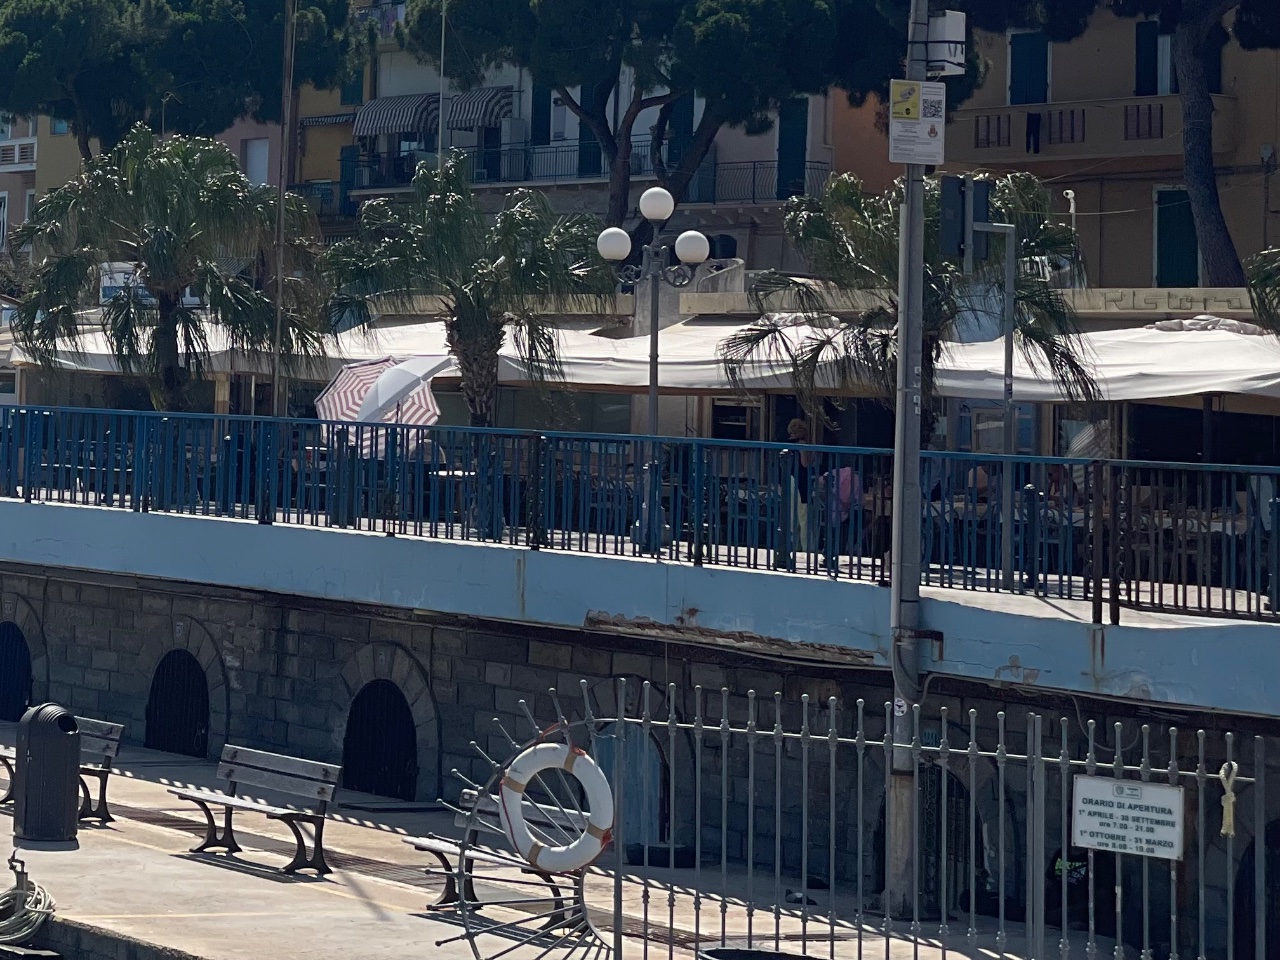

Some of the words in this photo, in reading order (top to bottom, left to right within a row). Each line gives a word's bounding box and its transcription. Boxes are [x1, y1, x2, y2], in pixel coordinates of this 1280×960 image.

[1081, 797, 1114, 808] ORARIO
[1116, 802, 1125, 810] DI
[1127, 803, 1173, 815] APERTURA
[1087, 810, 1114, 820] APRILE
[1131, 816, 1176, 828] SETTEMBRE
[1113, 822, 1128, 830] 7.00
[1089, 831, 1126, 842] OTTOBRE
[1145, 838, 1174, 848] MARZO
